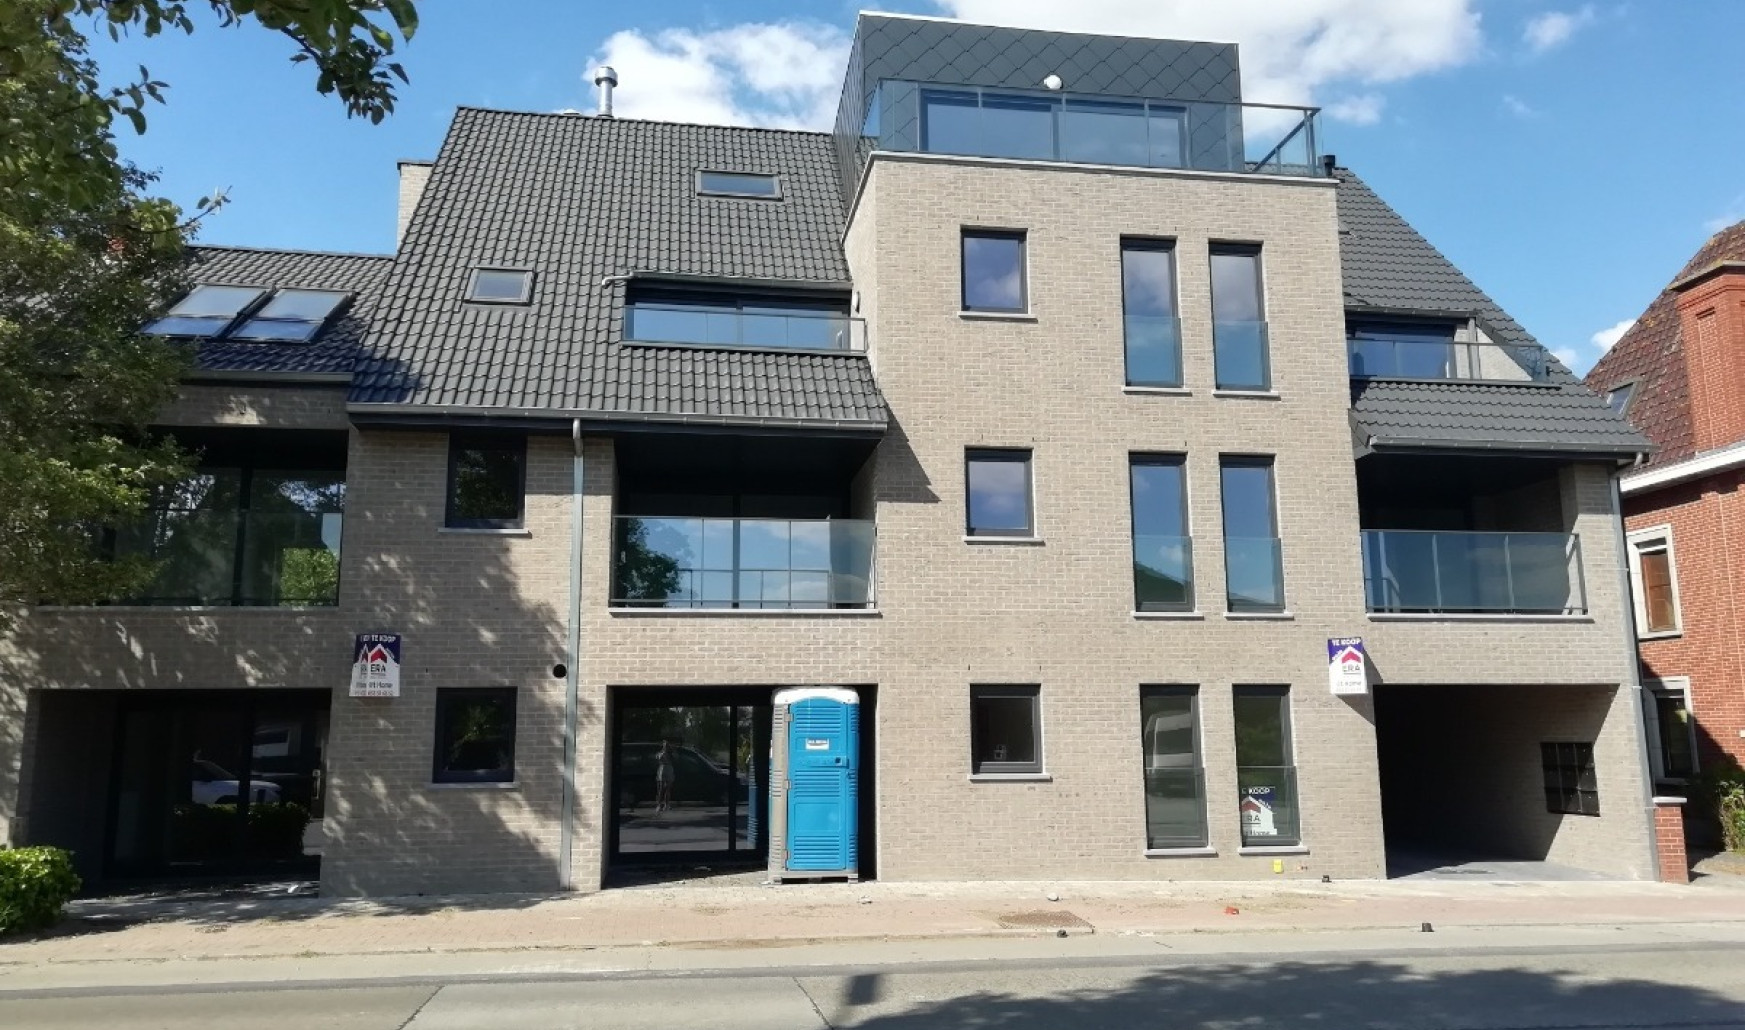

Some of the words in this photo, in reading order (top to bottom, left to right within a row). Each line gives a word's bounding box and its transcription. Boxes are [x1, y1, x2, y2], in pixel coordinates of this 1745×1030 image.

[1340, 637, 1361, 645] KOOP
[370, 663, 386, 673] ERA
[1342, 664, 1361, 672] ERA
